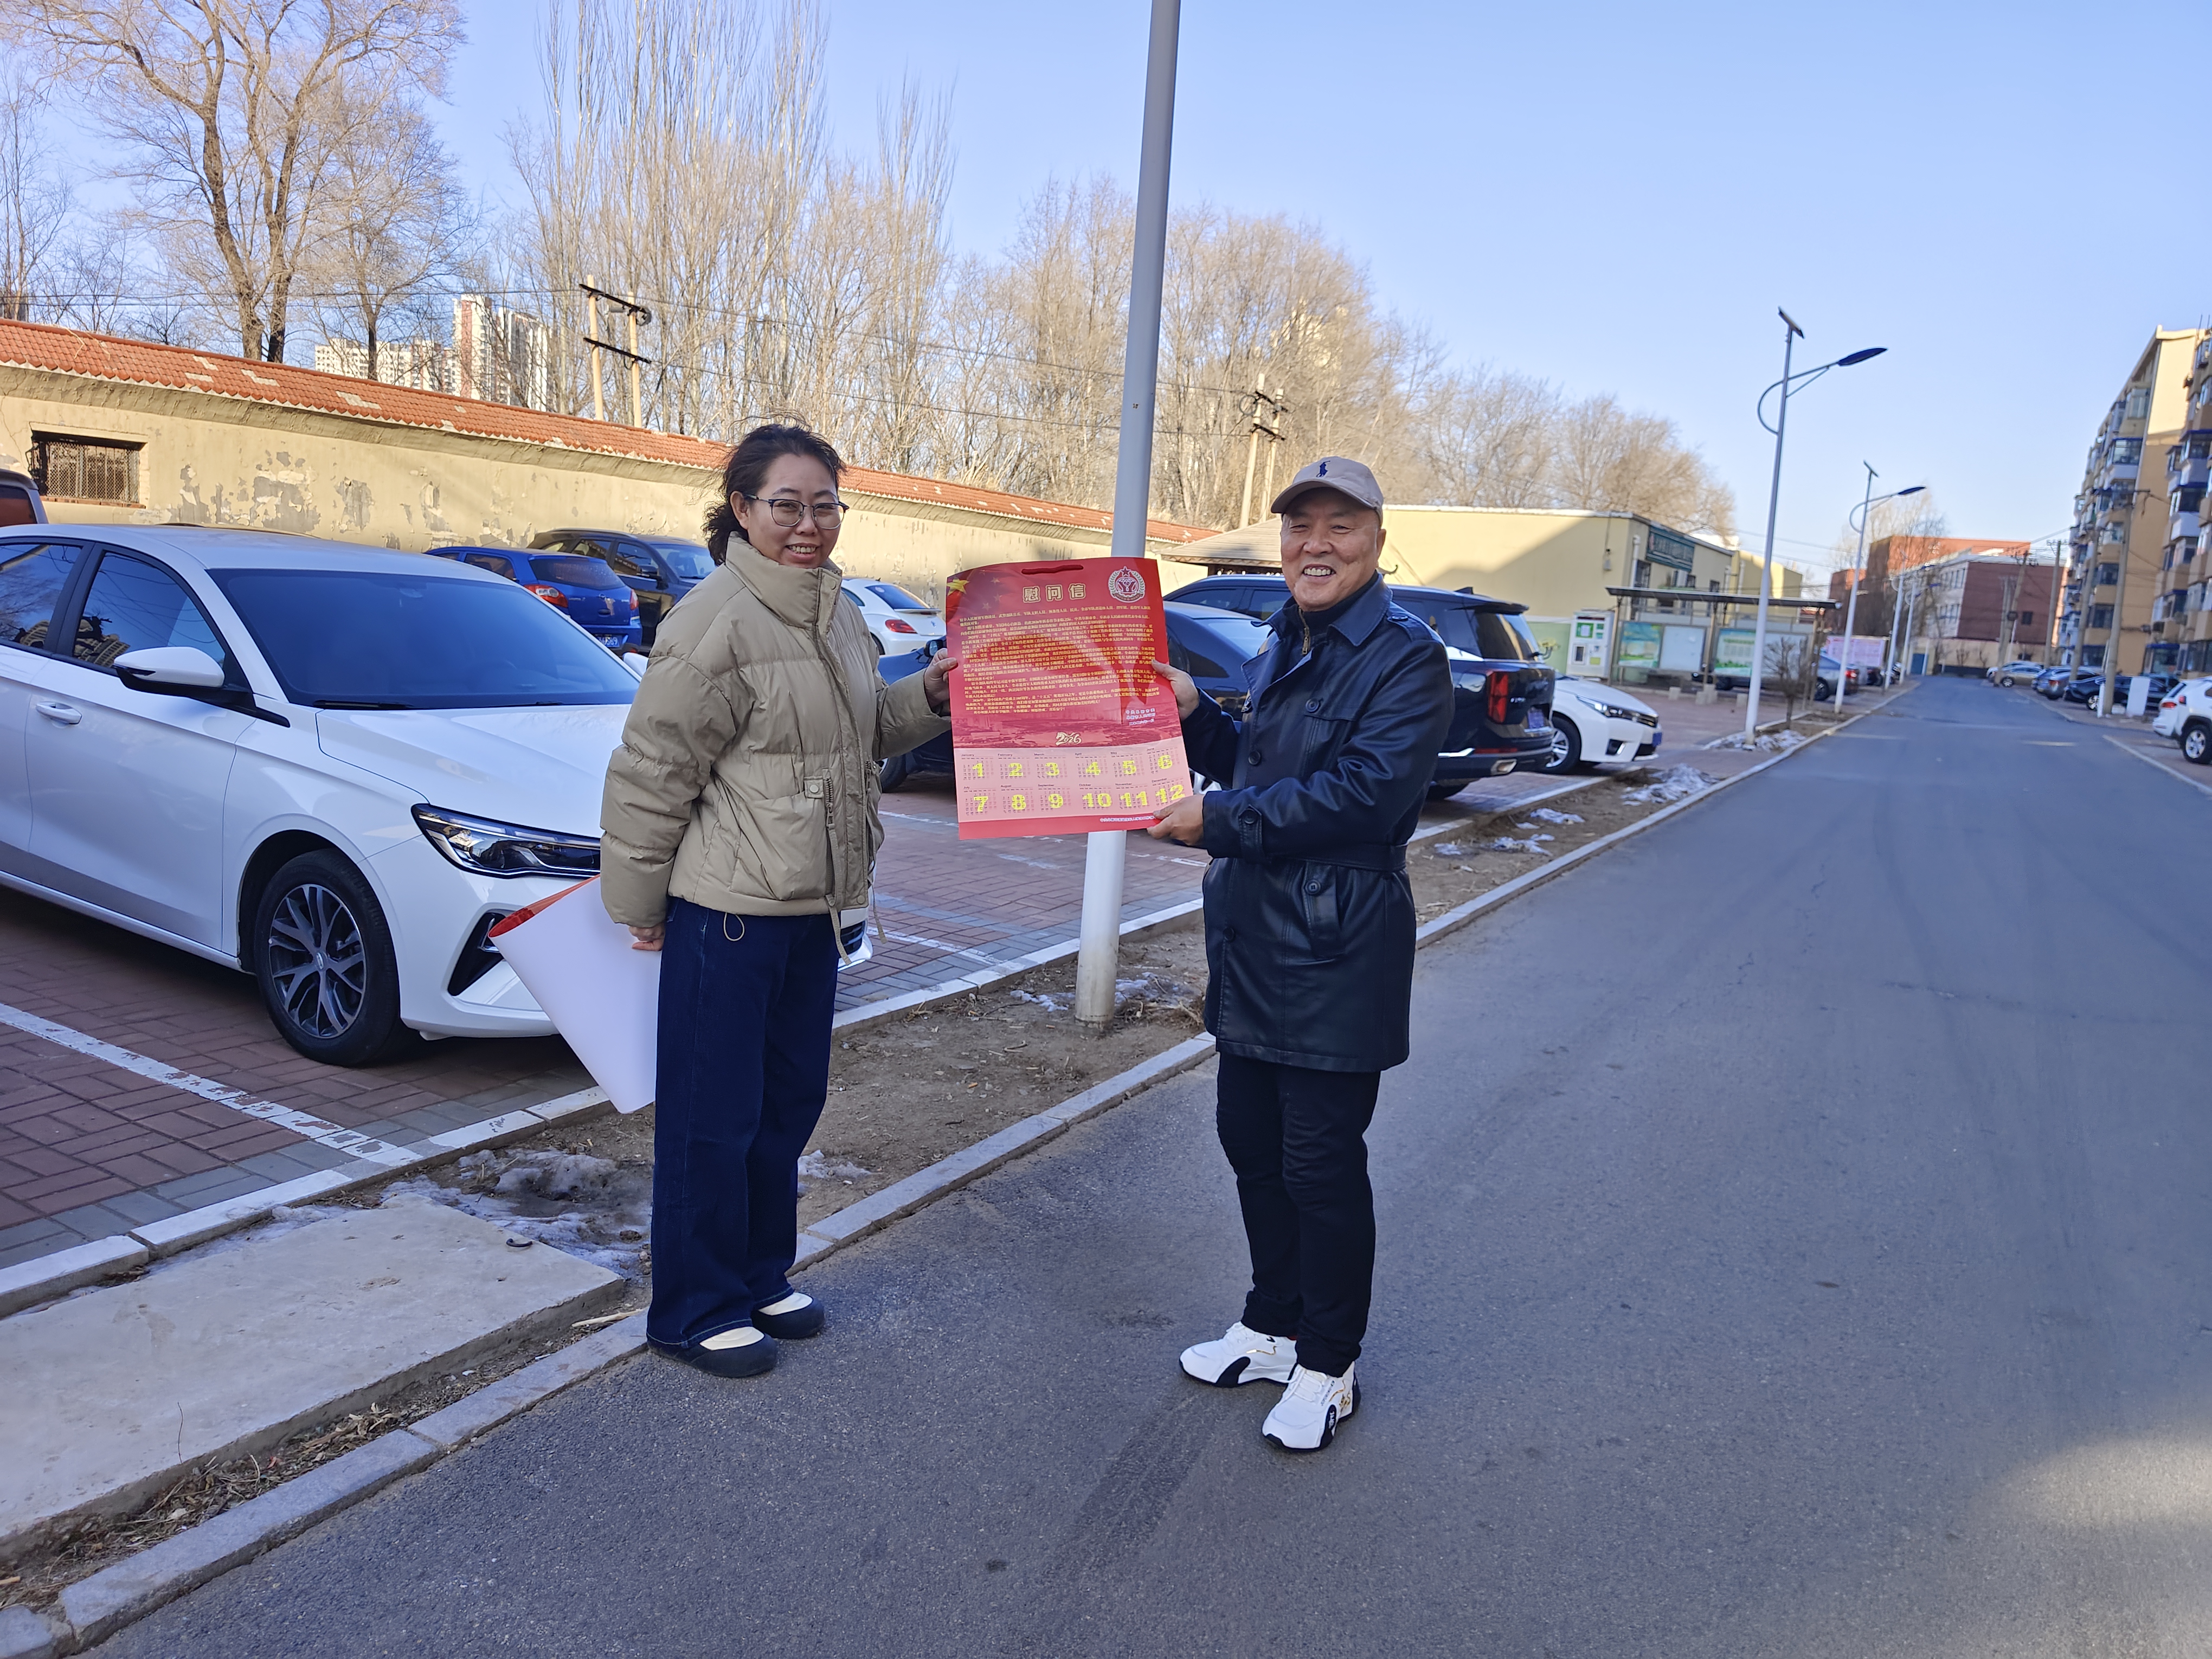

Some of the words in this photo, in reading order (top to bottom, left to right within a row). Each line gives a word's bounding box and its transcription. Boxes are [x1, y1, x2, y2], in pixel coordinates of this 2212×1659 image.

[1023, 583, 1086, 603] 慰问信
[1055, 732, 1082, 746] 2026
[1045, 762, 1059, 776] 3
[1086, 762, 1101, 775] 4
[1122, 760, 1137, 775] 5
[1158, 755, 1173, 769] 6
[972, 763, 983, 777] 1
[1008, 763, 1023, 776] 2
[1048, 793, 1063, 808] 9
[1082, 793, 1112, 807] 10
[1120, 791, 1148, 807] 11
[1155, 785, 1185, 803] 12
[974, 796, 988, 812] 7
[1012, 794, 1026, 810] 8
